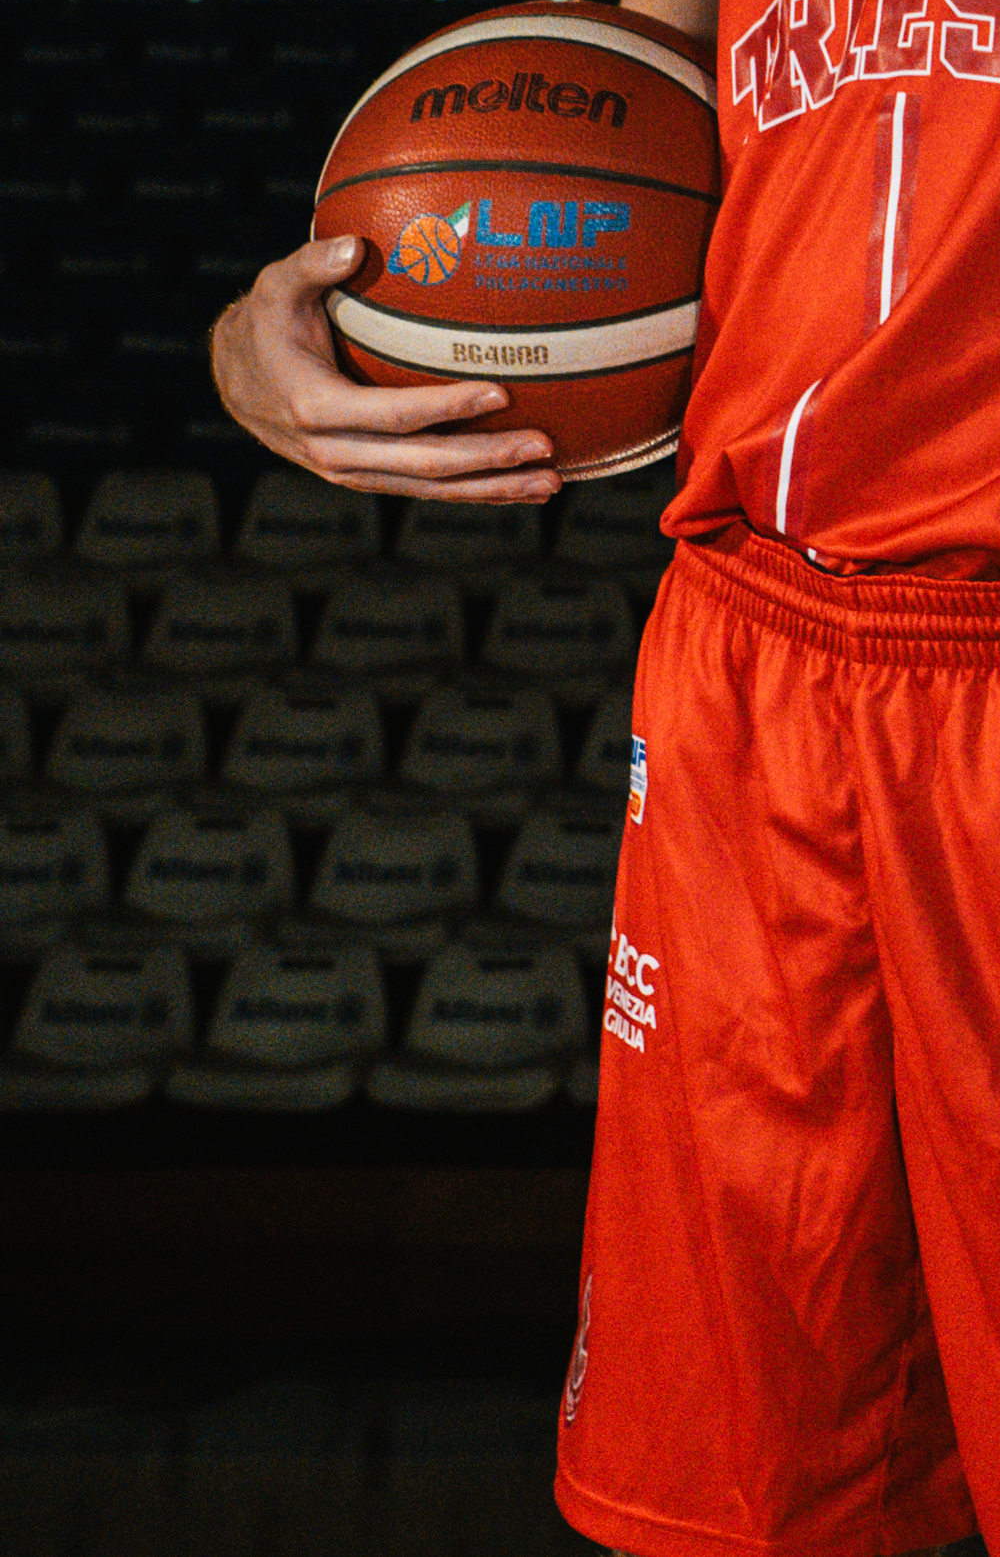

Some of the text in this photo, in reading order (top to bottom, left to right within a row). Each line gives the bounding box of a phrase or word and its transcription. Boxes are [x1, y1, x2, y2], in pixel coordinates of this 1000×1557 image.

[410, 72, 629, 129] molten
[476, 199, 631, 248] LNP
[475, 253, 628, 271] LEGA NAZIONALE
[475, 274, 629, 292] PALLACANESTRO
[452, 343, 550, 365] BG4000
[614, 933, 660, 996] BCC
[606, 975, 657, 1030] VENEZIA
[604, 1007, 645, 1054] GIULIA
